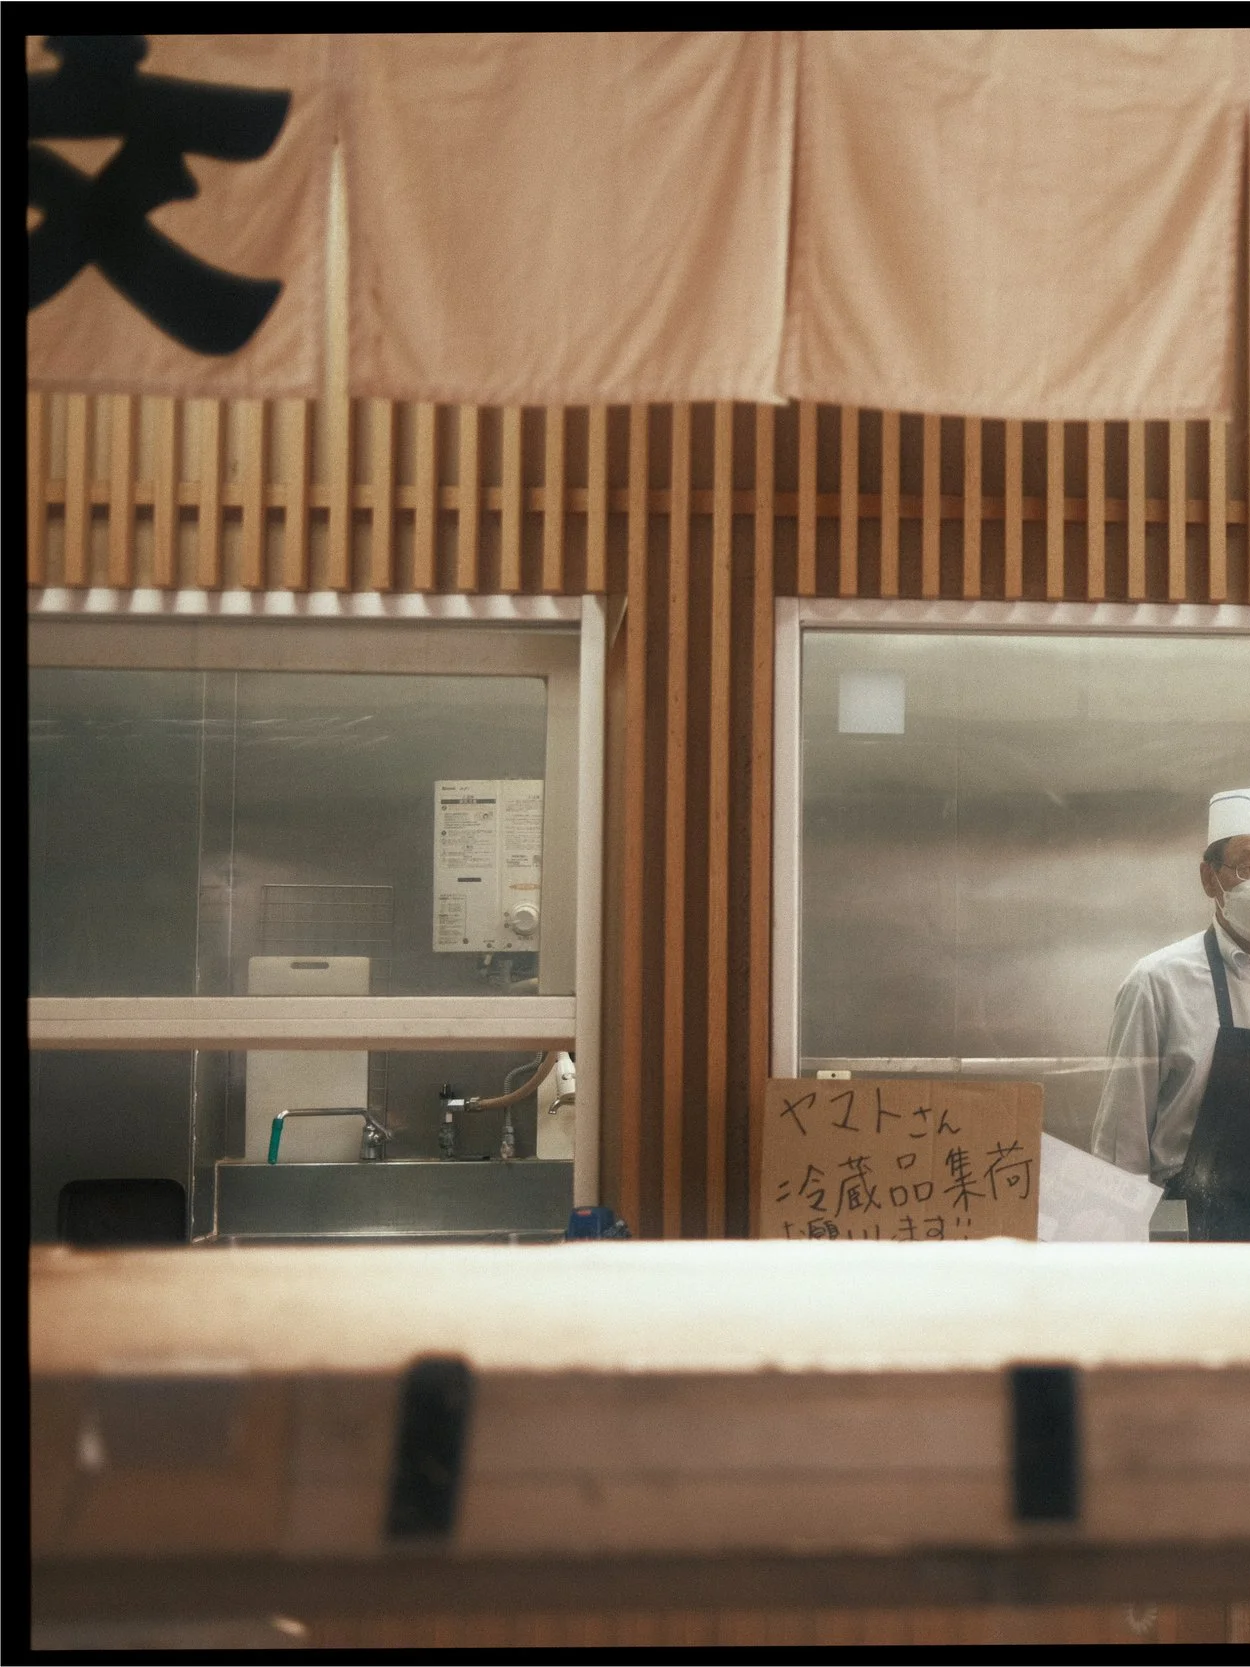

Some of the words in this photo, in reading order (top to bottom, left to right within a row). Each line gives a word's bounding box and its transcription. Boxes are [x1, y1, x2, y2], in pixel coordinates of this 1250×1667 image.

[780, 1087, 962, 1139] ヤマトさん
[776, 1140, 1034, 1218] 冷蔵品集荷
